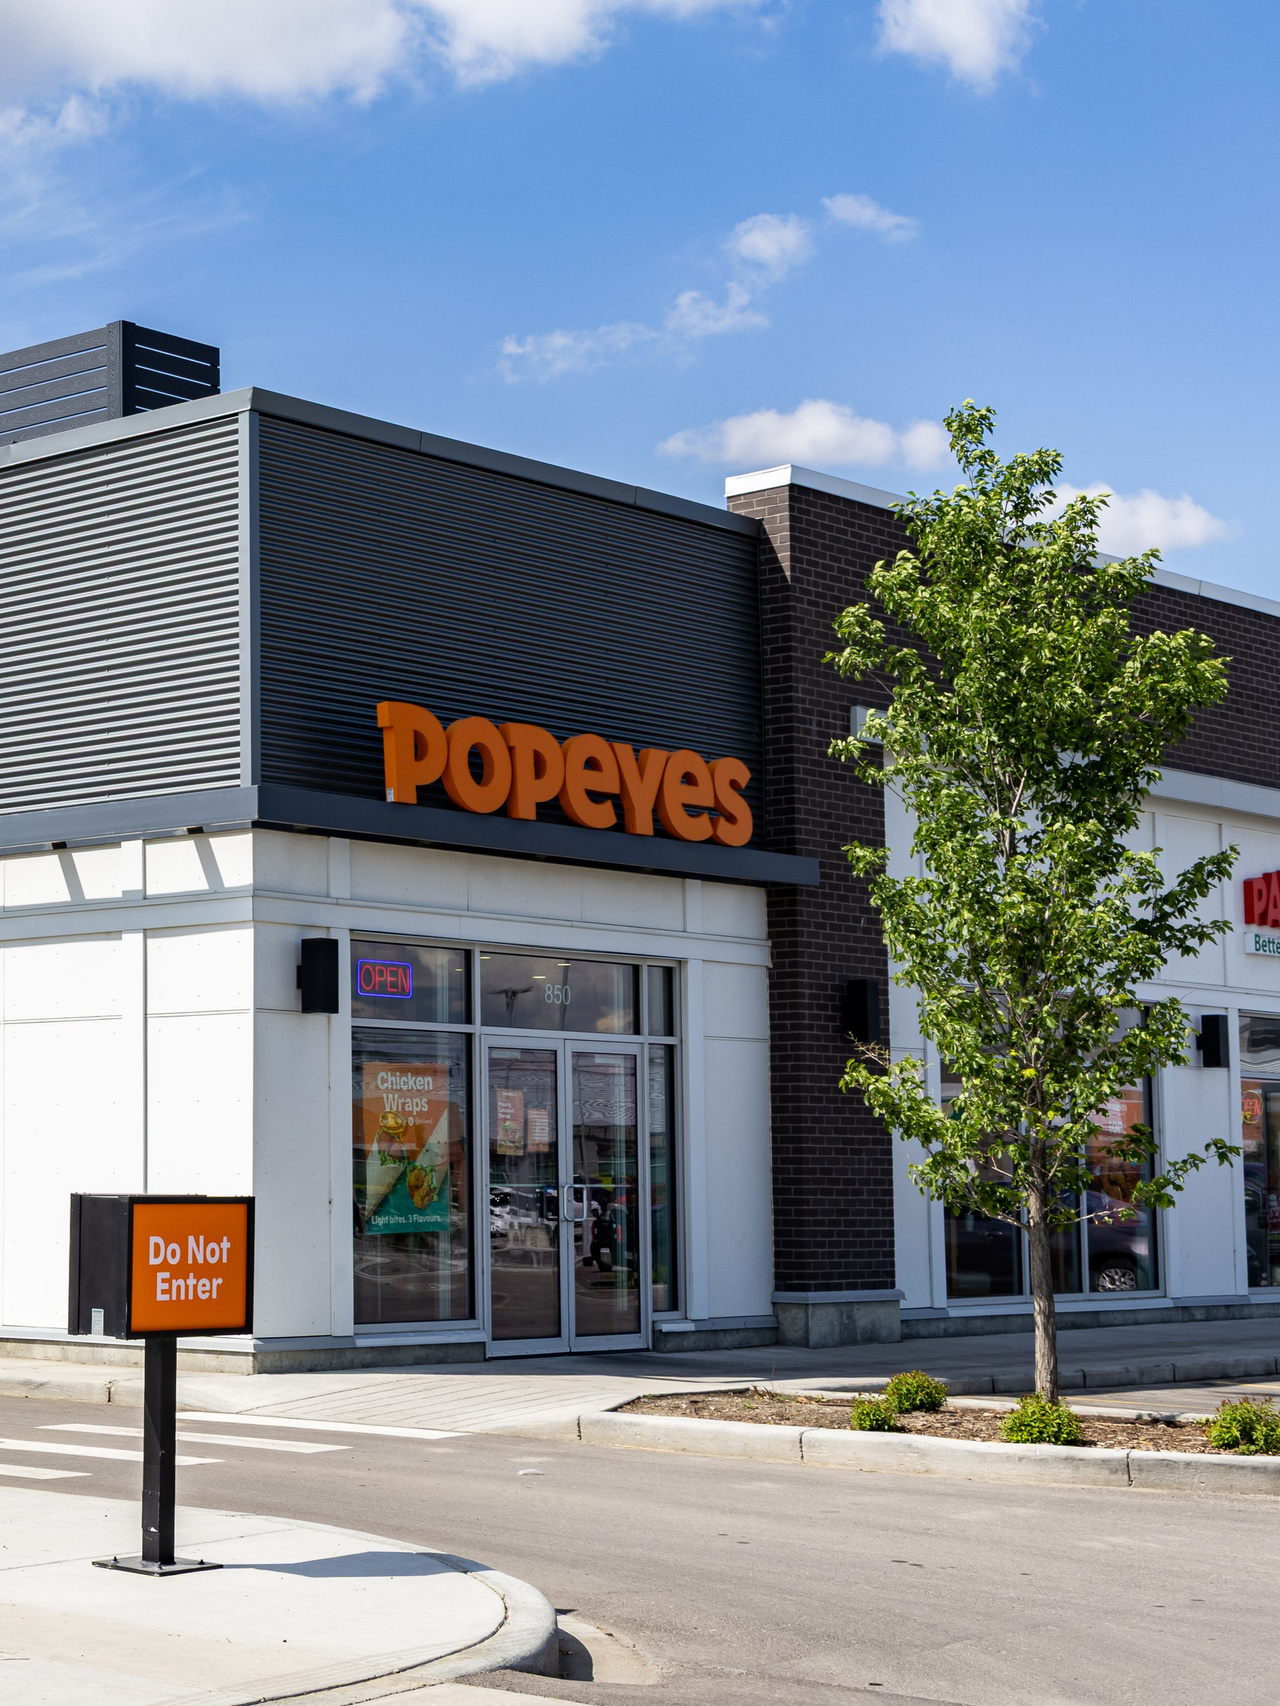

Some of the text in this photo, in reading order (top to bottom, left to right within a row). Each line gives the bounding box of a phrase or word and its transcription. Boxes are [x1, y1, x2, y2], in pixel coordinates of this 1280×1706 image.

[360, 964, 410, 994] OPEN
[545, 983, 571, 1005] 850
[377, 1071, 433, 1091] Chicken
[383, 1093, 428, 1115] Wraps
[371, 1215, 389, 1226] Light
[408, 1214, 413, 1223] 3
[149, 1235, 231, 1265] Do Not
[156, 1272, 223, 1302] Enter
